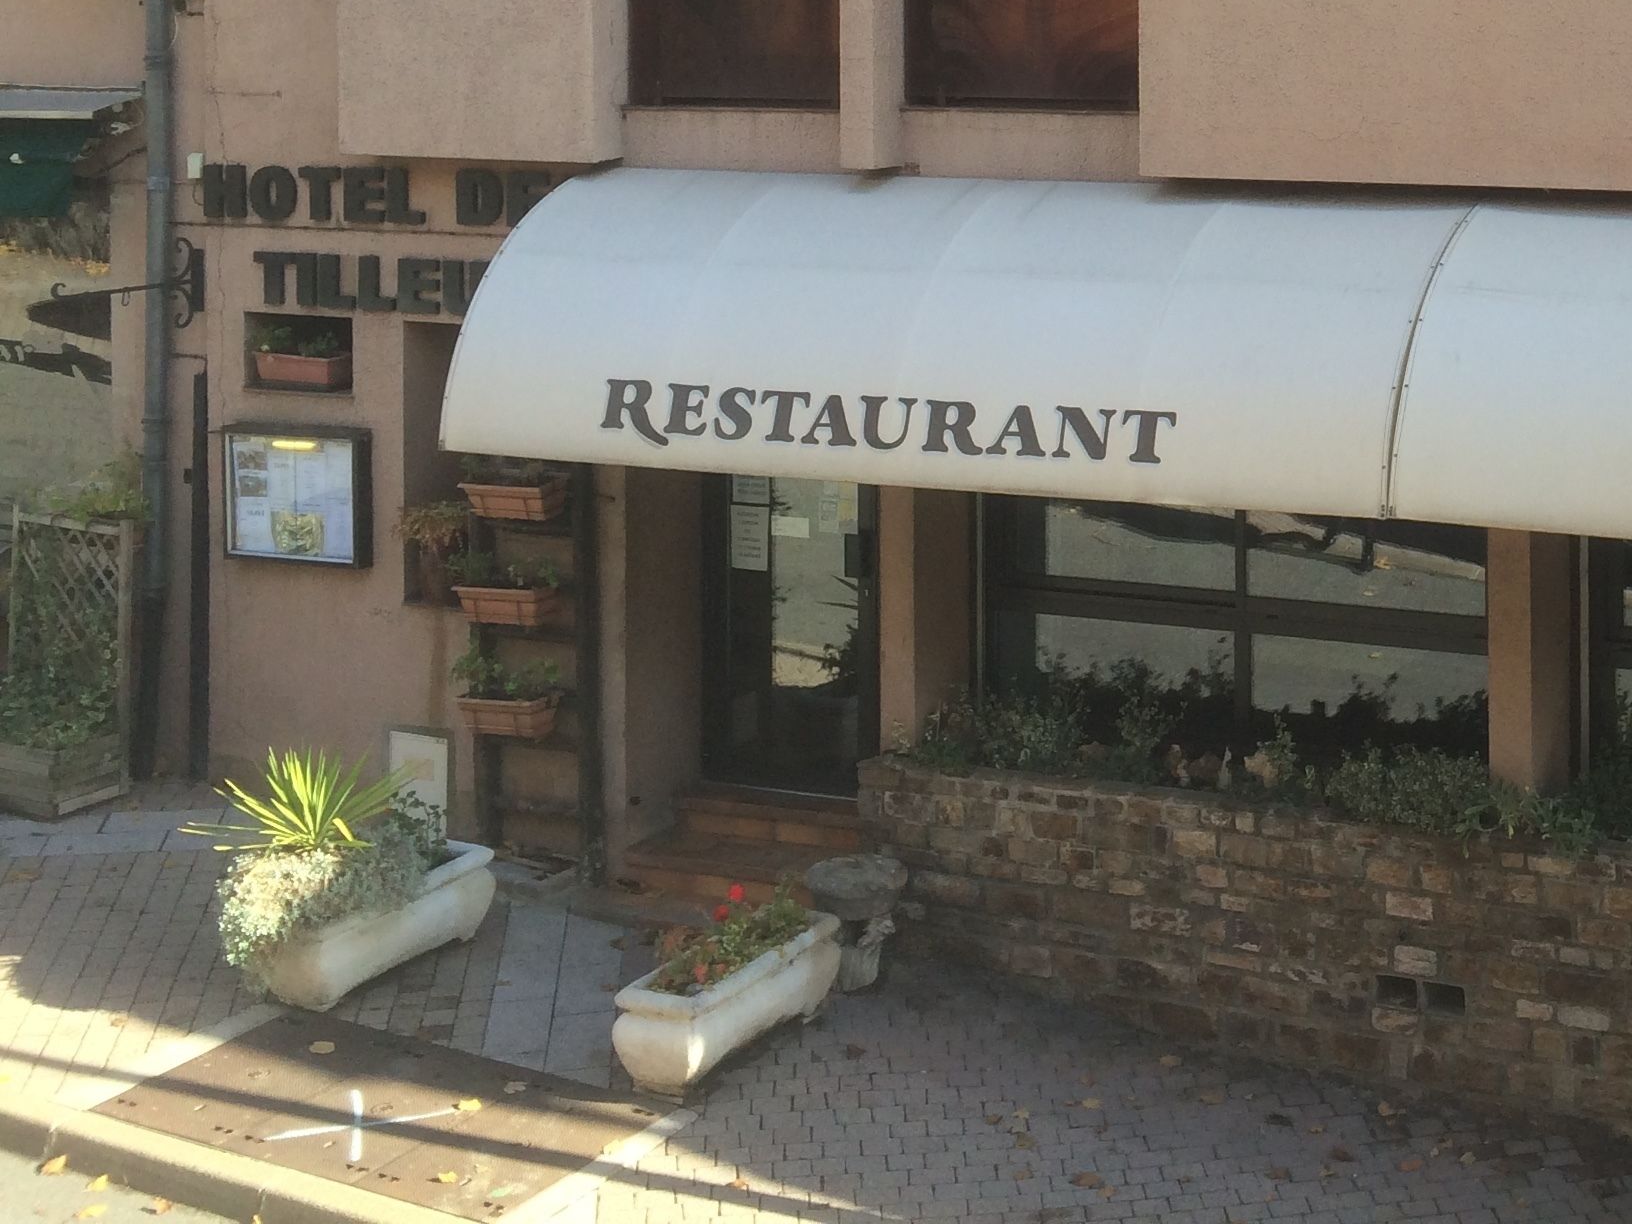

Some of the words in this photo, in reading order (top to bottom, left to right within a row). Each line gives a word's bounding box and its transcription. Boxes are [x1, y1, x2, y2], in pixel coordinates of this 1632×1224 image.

[203, 163, 426, 226] HOTEL
[455, 167, 552, 227] DE
[253, 251, 492, 316] TILLEU
[600, 379, 1177, 464] RESTAURANT
